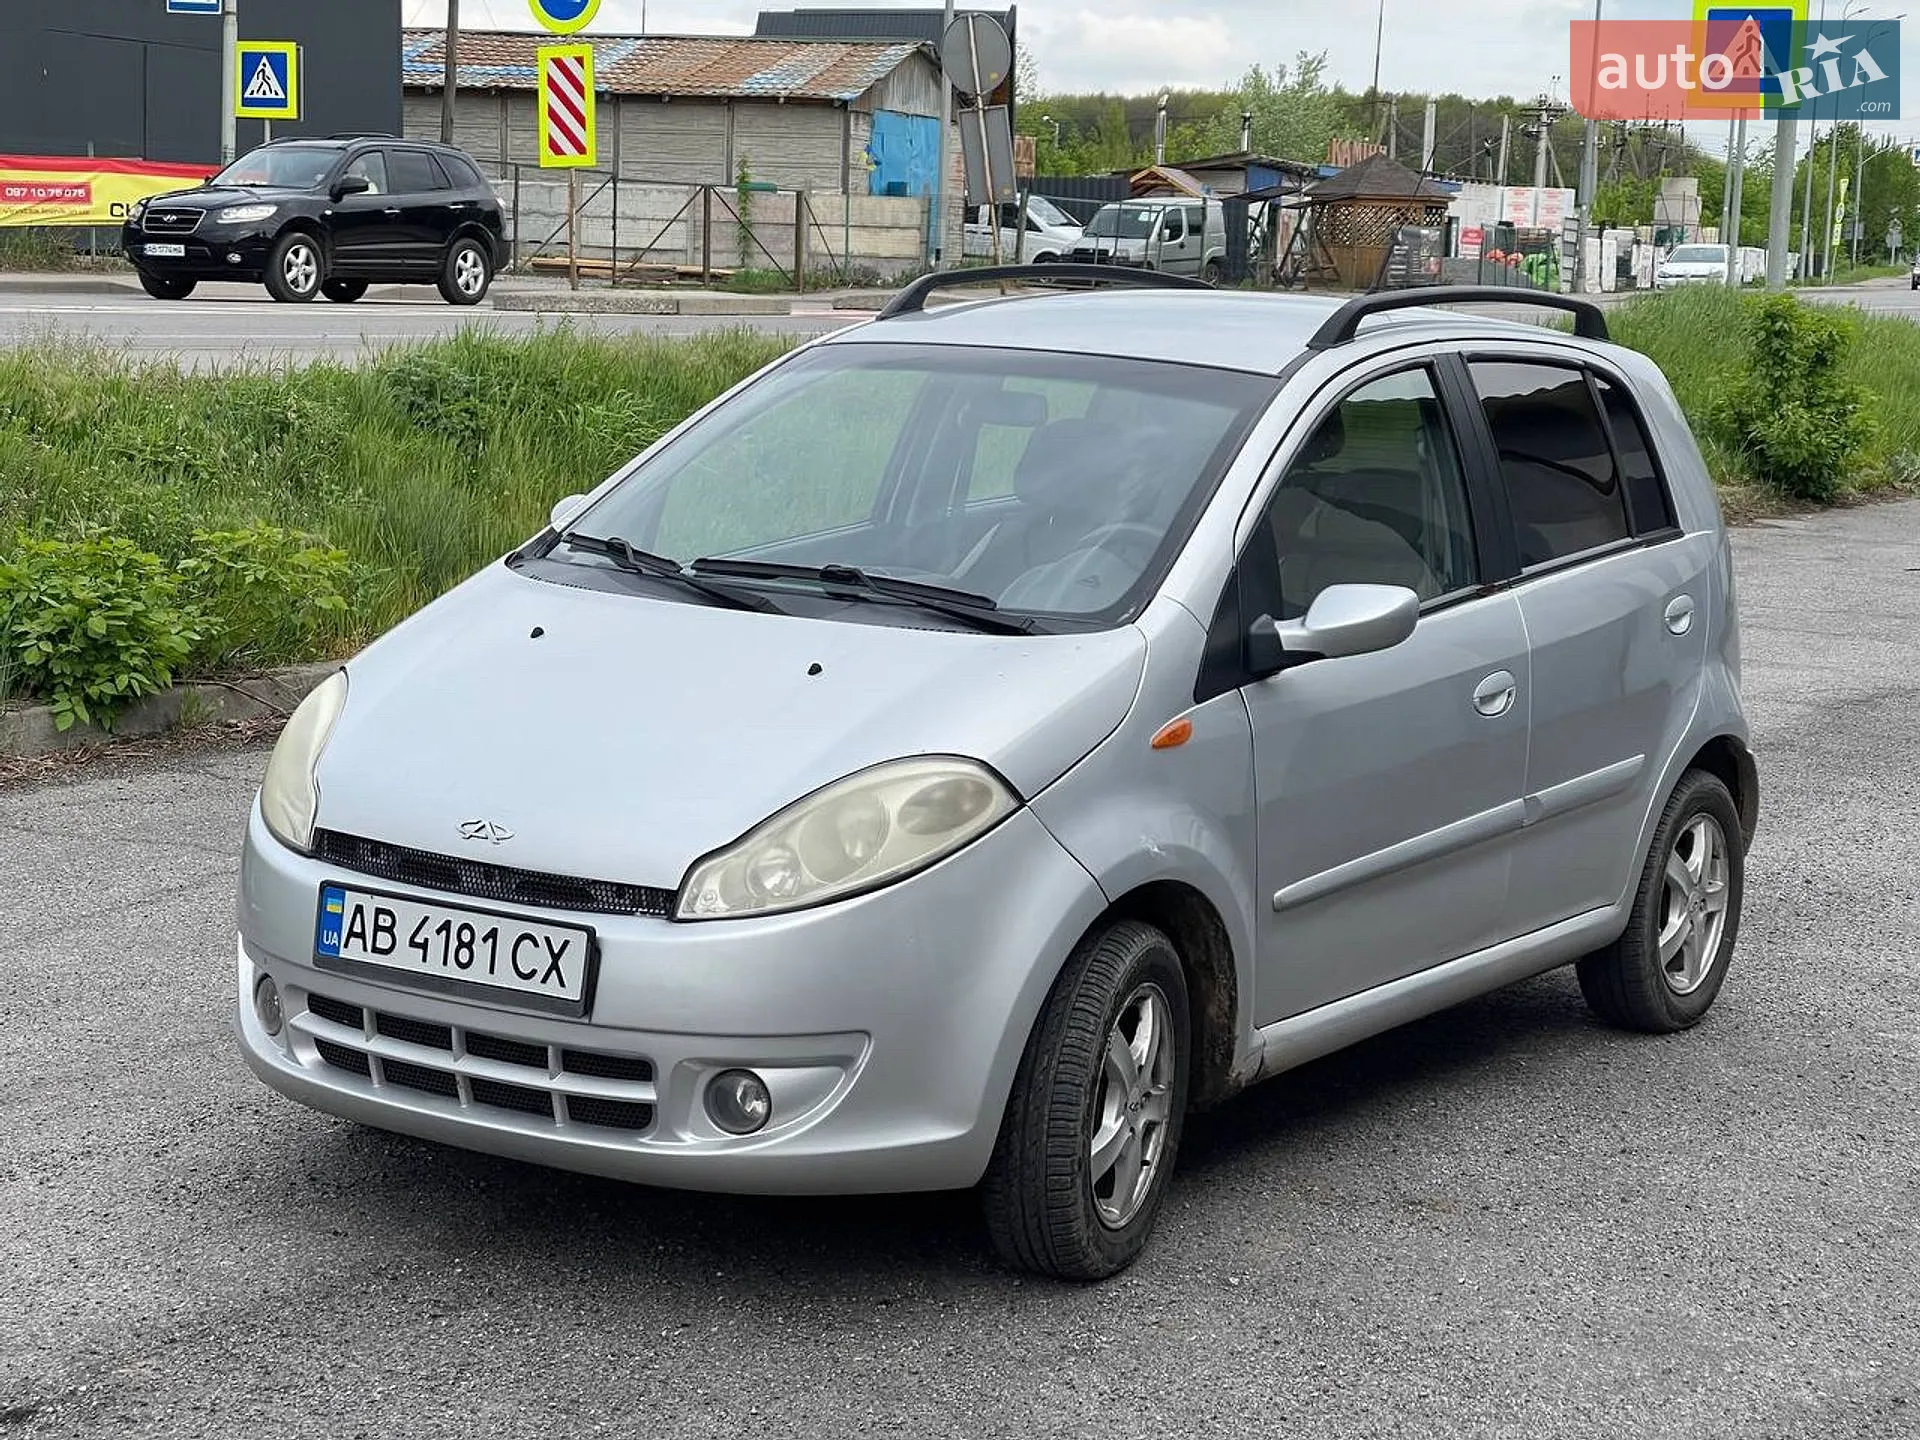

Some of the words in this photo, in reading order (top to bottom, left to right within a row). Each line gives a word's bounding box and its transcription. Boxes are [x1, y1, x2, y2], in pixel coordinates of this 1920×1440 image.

[323, 930, 339, 947] UA
[344, 903, 397, 955] AB
[408, 915, 499, 975] 4181
[511, 932, 570, 988] CX
